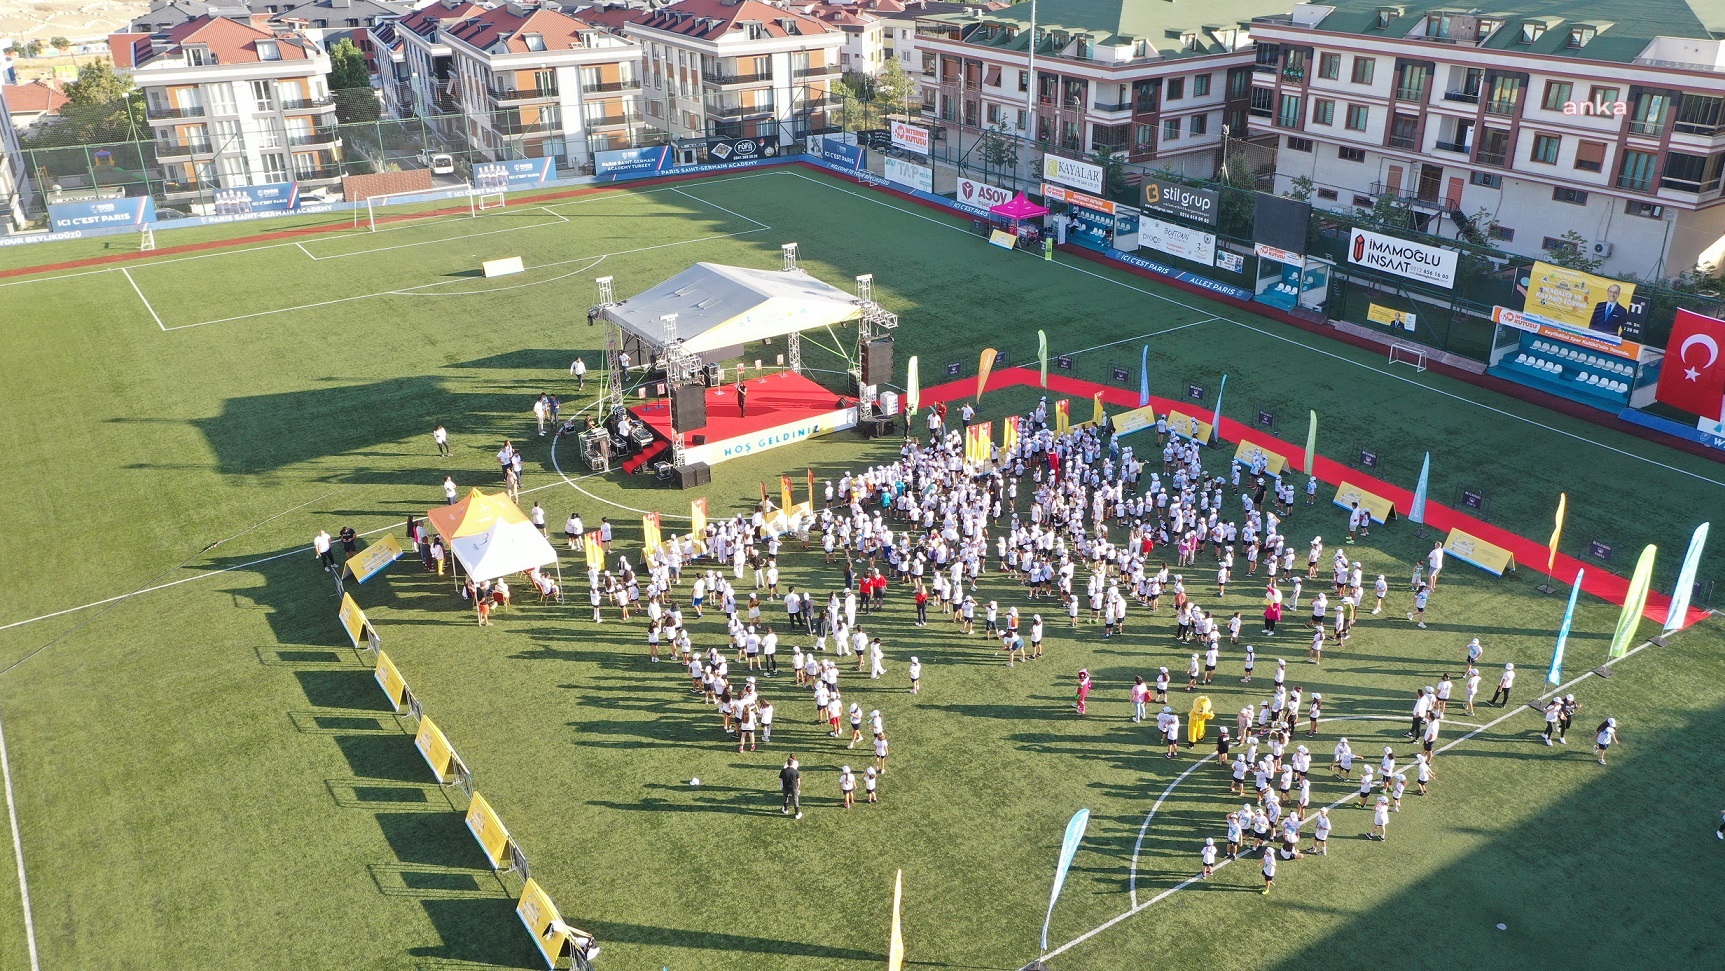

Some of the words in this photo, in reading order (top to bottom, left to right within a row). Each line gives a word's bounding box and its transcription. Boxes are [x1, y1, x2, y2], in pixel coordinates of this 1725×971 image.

[905, 127, 927, 138] INTERNET
[905, 135, 927, 146] KUTUSU
[617, 157, 656, 165] SAINT-GERMAIN
[681, 163, 728, 174] SAINT-GERMAIN
[728, 160, 758, 169] ACADEMY
[1058, 161, 1100, 182] KAYALAR
[978, 186, 1008, 205] ASOY
[1163, 187, 1180, 201] stil
[1181, 192, 1211, 210] grup
[57, 219, 71, 227] ICI
[72, 216, 100, 225] C'EST
[101, 212, 131, 222] PARIS
[209, 214, 234, 223] PARIS
[235, 209, 295, 221] SAINT-GERMAIN
[297, 204, 333, 214] ACADEMY
[974, 208, 988, 217] PARIS
[0, 237, 24, 246] YOUR
[1368, 238, 1441, 266] İMAMOĞLU
[1120, 254, 1130, 262] ICI
[1130, 256, 1150, 268] C'EST
[1150, 263, 1170, 274] PARIS
[1190, 278, 1213, 289] ALLEZ
[1213, 283, 1236, 295] PARIS
[1513, 319, 1538, 330] KUTUSU
[724, 442, 752, 458] HOŞ
[757, 424, 820, 448] GELDİNİZ
